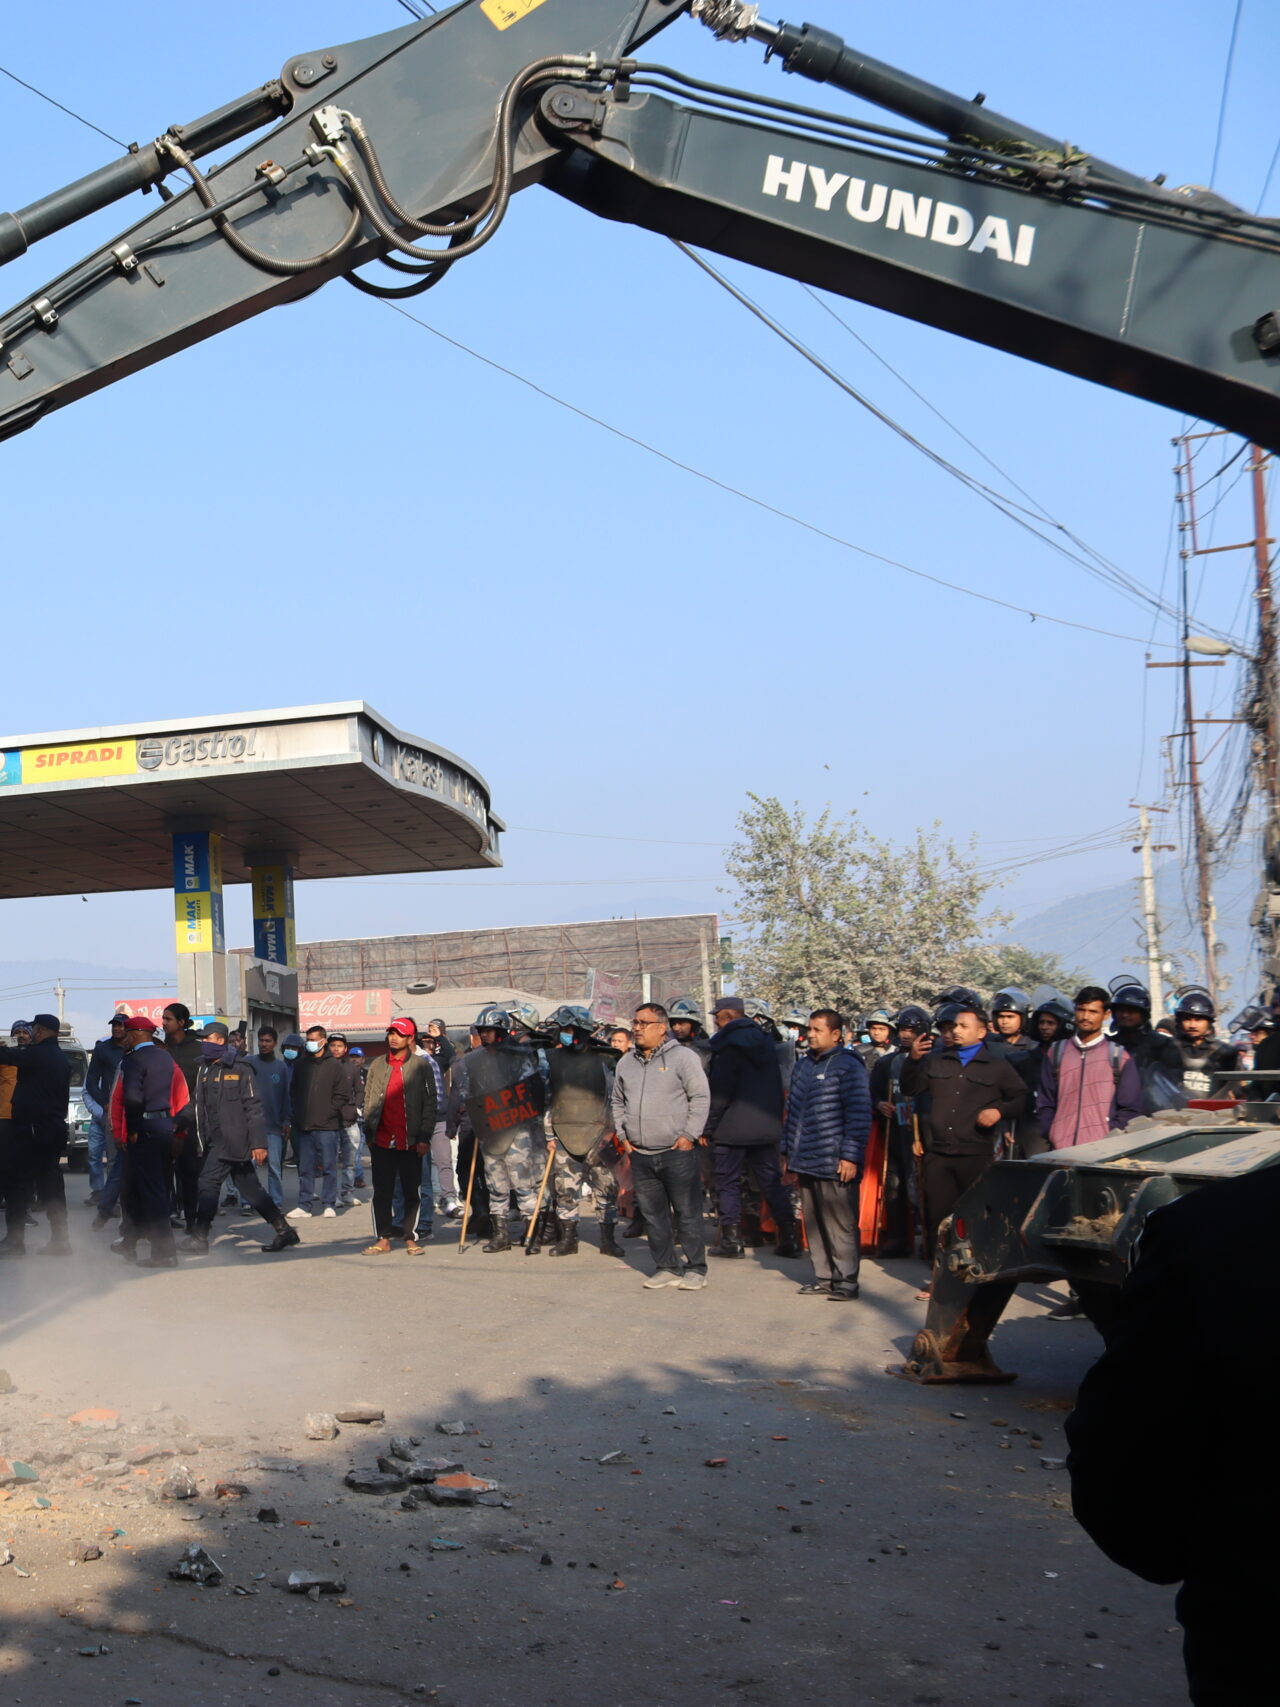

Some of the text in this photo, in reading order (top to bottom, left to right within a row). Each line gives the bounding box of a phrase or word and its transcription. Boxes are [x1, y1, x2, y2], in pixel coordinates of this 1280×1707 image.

[762, 154, 1037, 267] HYUNDAI
[35, 747, 122, 768] SIPRADI
[164, 729, 257, 766] Castrol
[184, 845, 194, 875] MAK
[186, 900, 196, 929] MAK
[267, 933, 277, 961] MAK
[487, 1102, 539, 1132] NEPAL
